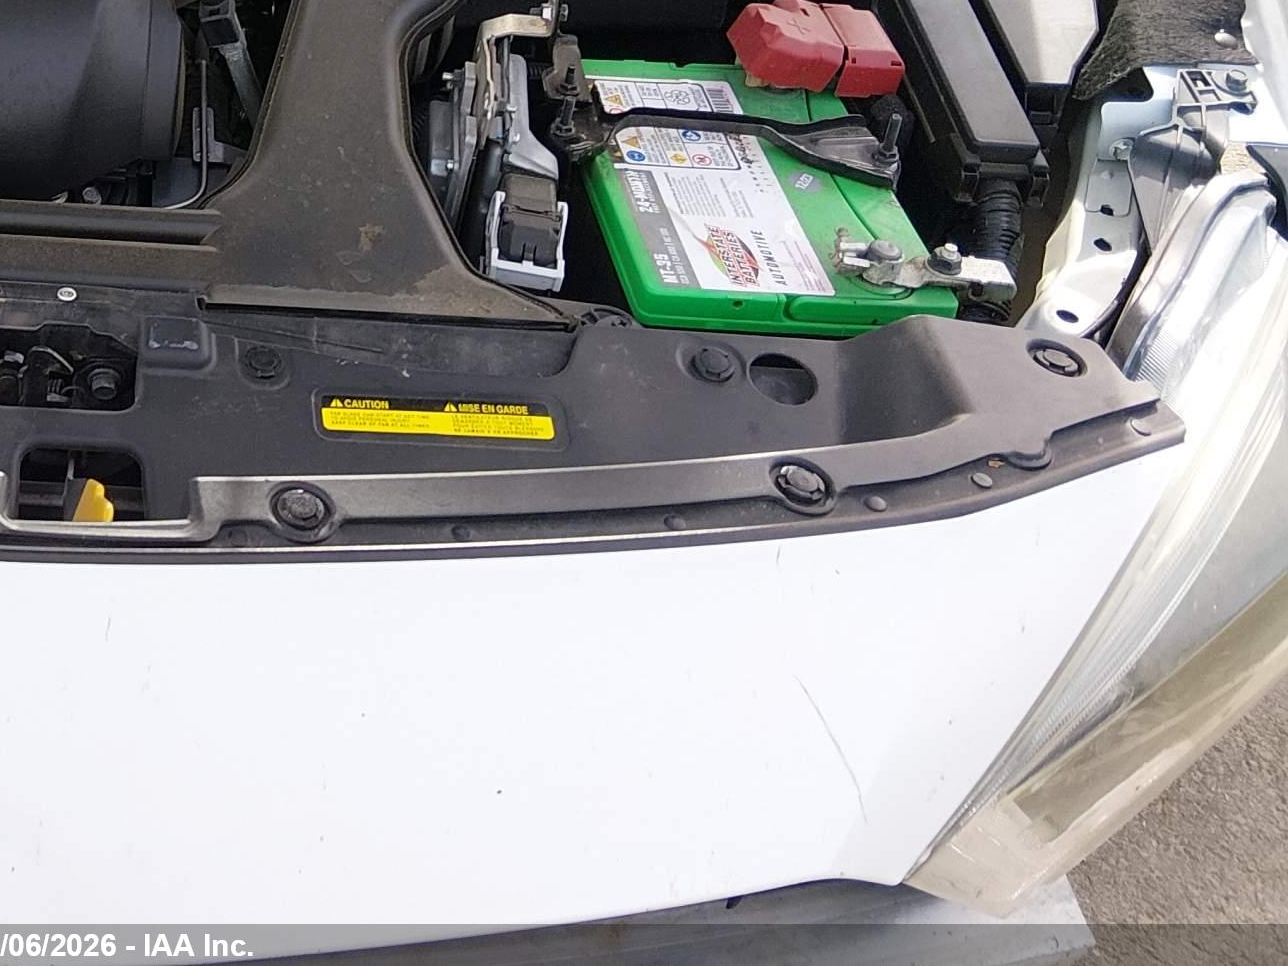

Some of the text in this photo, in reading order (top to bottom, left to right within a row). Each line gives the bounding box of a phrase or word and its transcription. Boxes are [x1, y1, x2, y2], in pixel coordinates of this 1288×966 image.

[653, 253, 679, 284] MT-35
[708, 226, 745, 284] INTERSTATE
[722, 230, 757, 285] BATTERIES
[750, 229, 788, 286] AUTOMOTIVE
[343, 398, 390, 410] CAUTION
[458, 403, 529, 415] MISE EN GARDE
